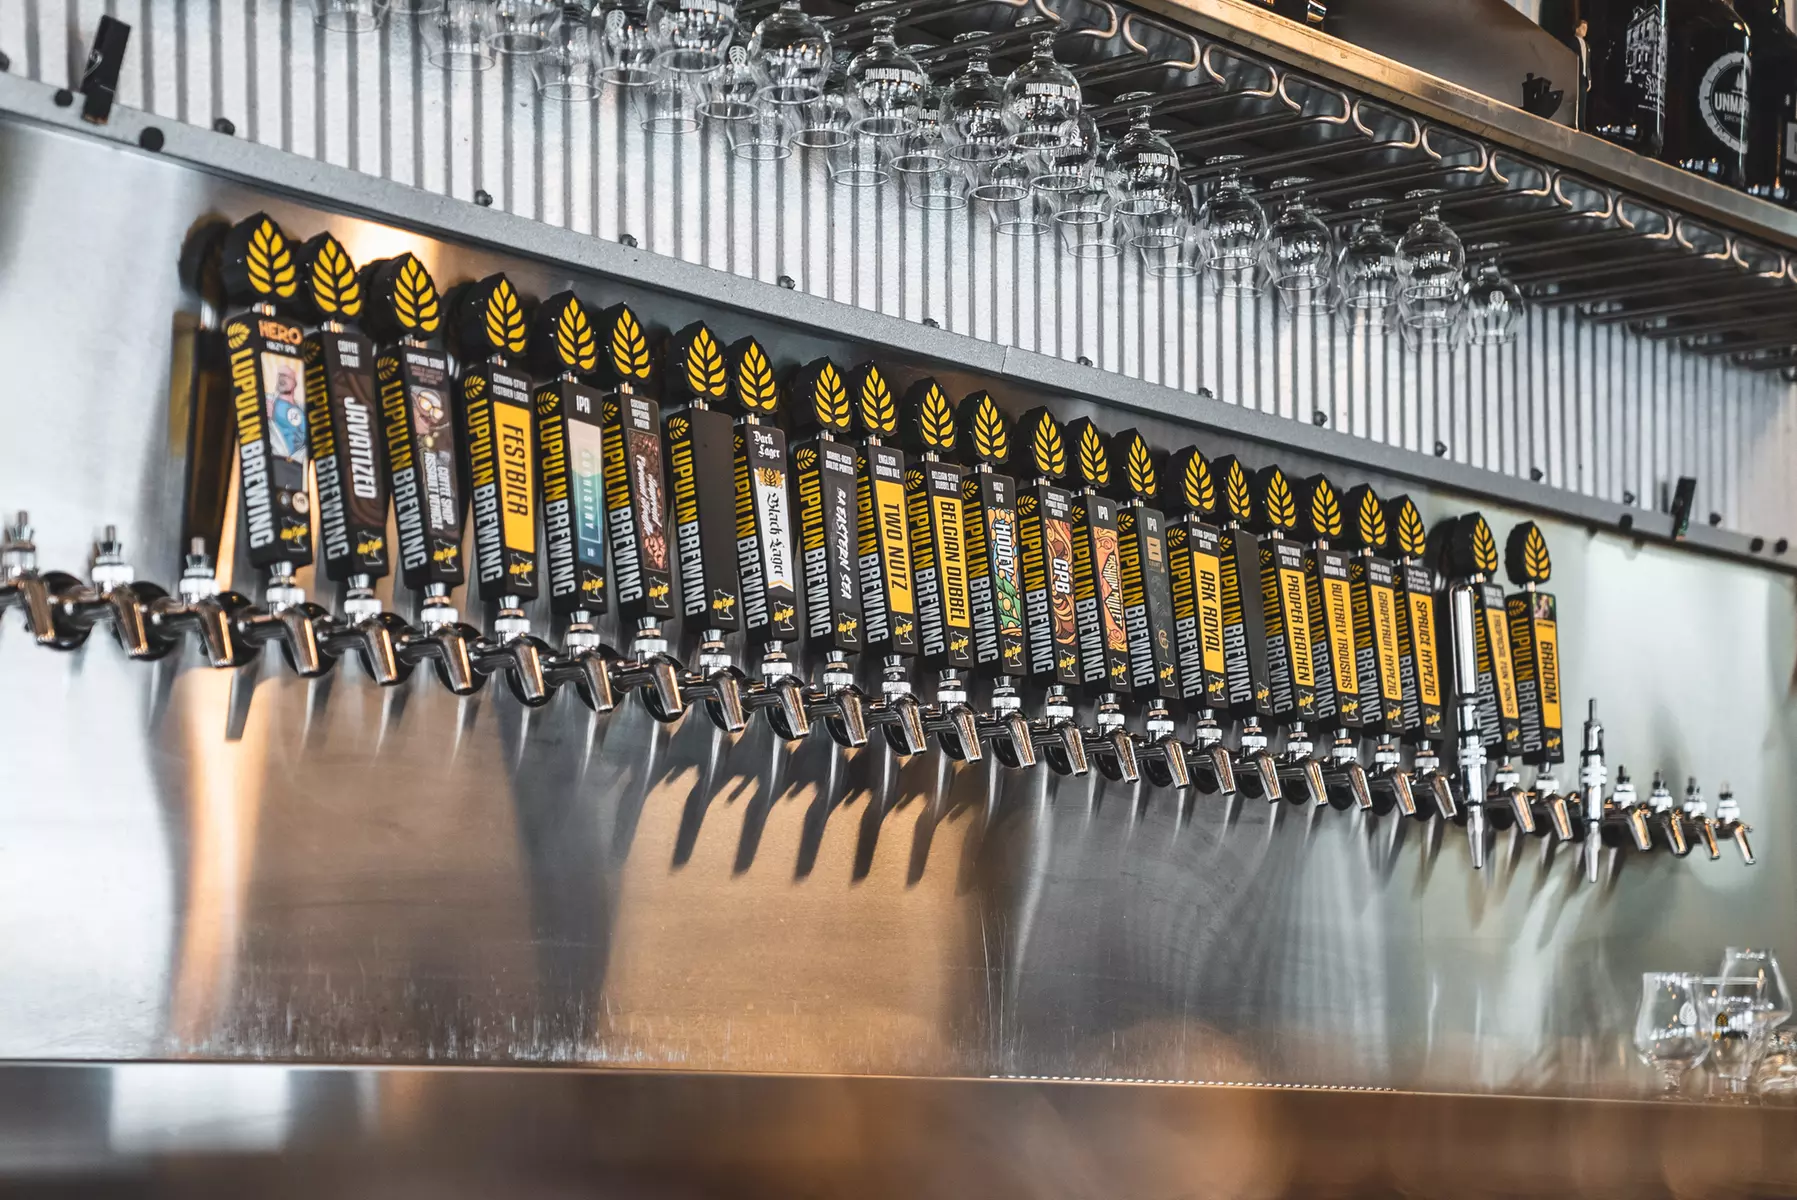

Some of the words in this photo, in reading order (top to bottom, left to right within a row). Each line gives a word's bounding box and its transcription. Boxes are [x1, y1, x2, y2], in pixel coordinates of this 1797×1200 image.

[865, 67, 900, 80] BREWING
[1025, 83, 1060, 96] BREWING
[1138, 152, 1169, 166] BREWING
[258, 319, 304, 345] HERO
[337, 340, 359, 354] COFFEE
[340, 353, 360, 368] STOUT
[231, 348, 262, 445] LUPULIN
[305, 364, 335, 460] LUPULIN
[380, 379, 413, 472] LUPULIN
[576, 395, 591, 415] IPA
[343, 396, 377, 500] JAVATIZED
[466, 397, 496, 487] LUPULIN
[502, 423, 528, 517] FESTBIER
[539, 414, 568, 503] LUPULIN
[602, 423, 631, 512] LUPULIN
[752, 430, 774, 446] Dark
[758, 445, 780, 459] Lager
[240, 440, 275, 549] BREWING
[315, 454, 349, 560] BREWING
[392, 466, 427, 571] BREWING
[670, 439, 698, 525] LUPULIN
[767, 492, 784, 536] Black
[799, 469, 825, 551] LUPULIN
[1097, 505, 1109, 521] IPA
[473, 482, 504, 584] BREWING
[545, 498, 577, 597] BREWING
[608, 505, 644, 604] BREWING
[769, 539, 785, 578] Lager
[883, 503, 903, 541] TWO
[906, 490, 935, 571] LUPULIN
[940, 500, 960, 563] BELGIAN
[963, 501, 989, 582] LUPULIN
[995, 522, 1014, 577] HOOEY
[1019, 515, 1046, 593] LUPULIN
[1147, 517, 1158, 532] IPA
[678, 521, 707, 617] BREWING
[737, 535, 770, 630] BREWING
[804, 547, 832, 638] BREWING
[840, 571, 853, 600] SEA
[858, 552, 889, 644] BREWING
[888, 545, 909, 591] NUTZ
[947, 565, 966, 622] DUBBEL
[1053, 558, 1071, 595] CPB
[1102, 554, 1119, 590] FASHION
[1169, 547, 1195, 620] LUPULIN
[1200, 569, 1216, 604] ARK
[1286, 574, 1304, 625] PROPER
[914, 567, 945, 657] BREWING
[969, 576, 999, 664] BREWING
[1025, 588, 1055, 675] BREWING
[1075, 597, 1106, 684] BREWING
[1105, 591, 1123, 627] MULLET
[1203, 605, 1221, 653] ROYAL
[1331, 583, 1347, 635] BUTTERFLY
[1377, 591, 1393, 652] GRAPEFRUIT
[1415, 600, 1431, 649] SPRUCE
[1124, 604, 1156, 688] BREWING
[1175, 616, 1204, 699] BREWING
[1223, 623, 1253, 705] BREWING
[1266, 634, 1293, 715] BREWING
[1293, 626, 1311, 682] HEATHEN
[1312, 640, 1337, 719] BREWING
[1336, 637, 1353, 690] TROUSERS
[1384, 652, 1399, 697] HYPEZIG
[1420, 649, 1437, 697] HYPEZIG
[1510, 616, 1534, 682] LUPULIN
[1356, 648, 1383, 725] BREWING
[1516, 680, 1542, 753] BREWING
